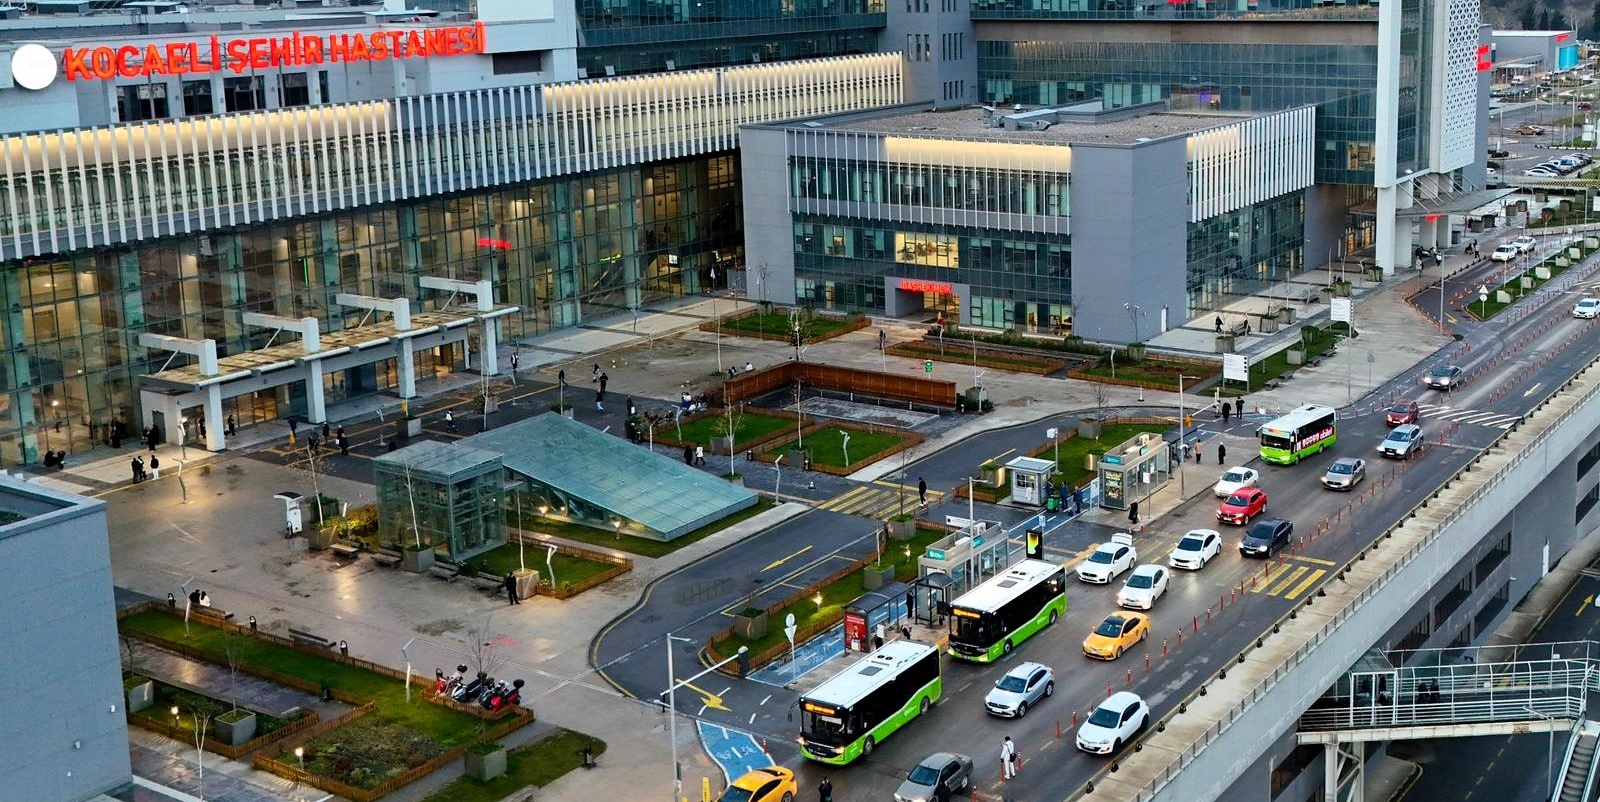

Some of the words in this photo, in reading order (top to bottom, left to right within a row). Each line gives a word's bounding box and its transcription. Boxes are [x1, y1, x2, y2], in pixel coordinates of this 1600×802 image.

[64, 35, 221, 81] KOCAELİ
[227, 31, 324, 74] ŞEHİR
[329, 21, 486, 63] HASTANESİ
